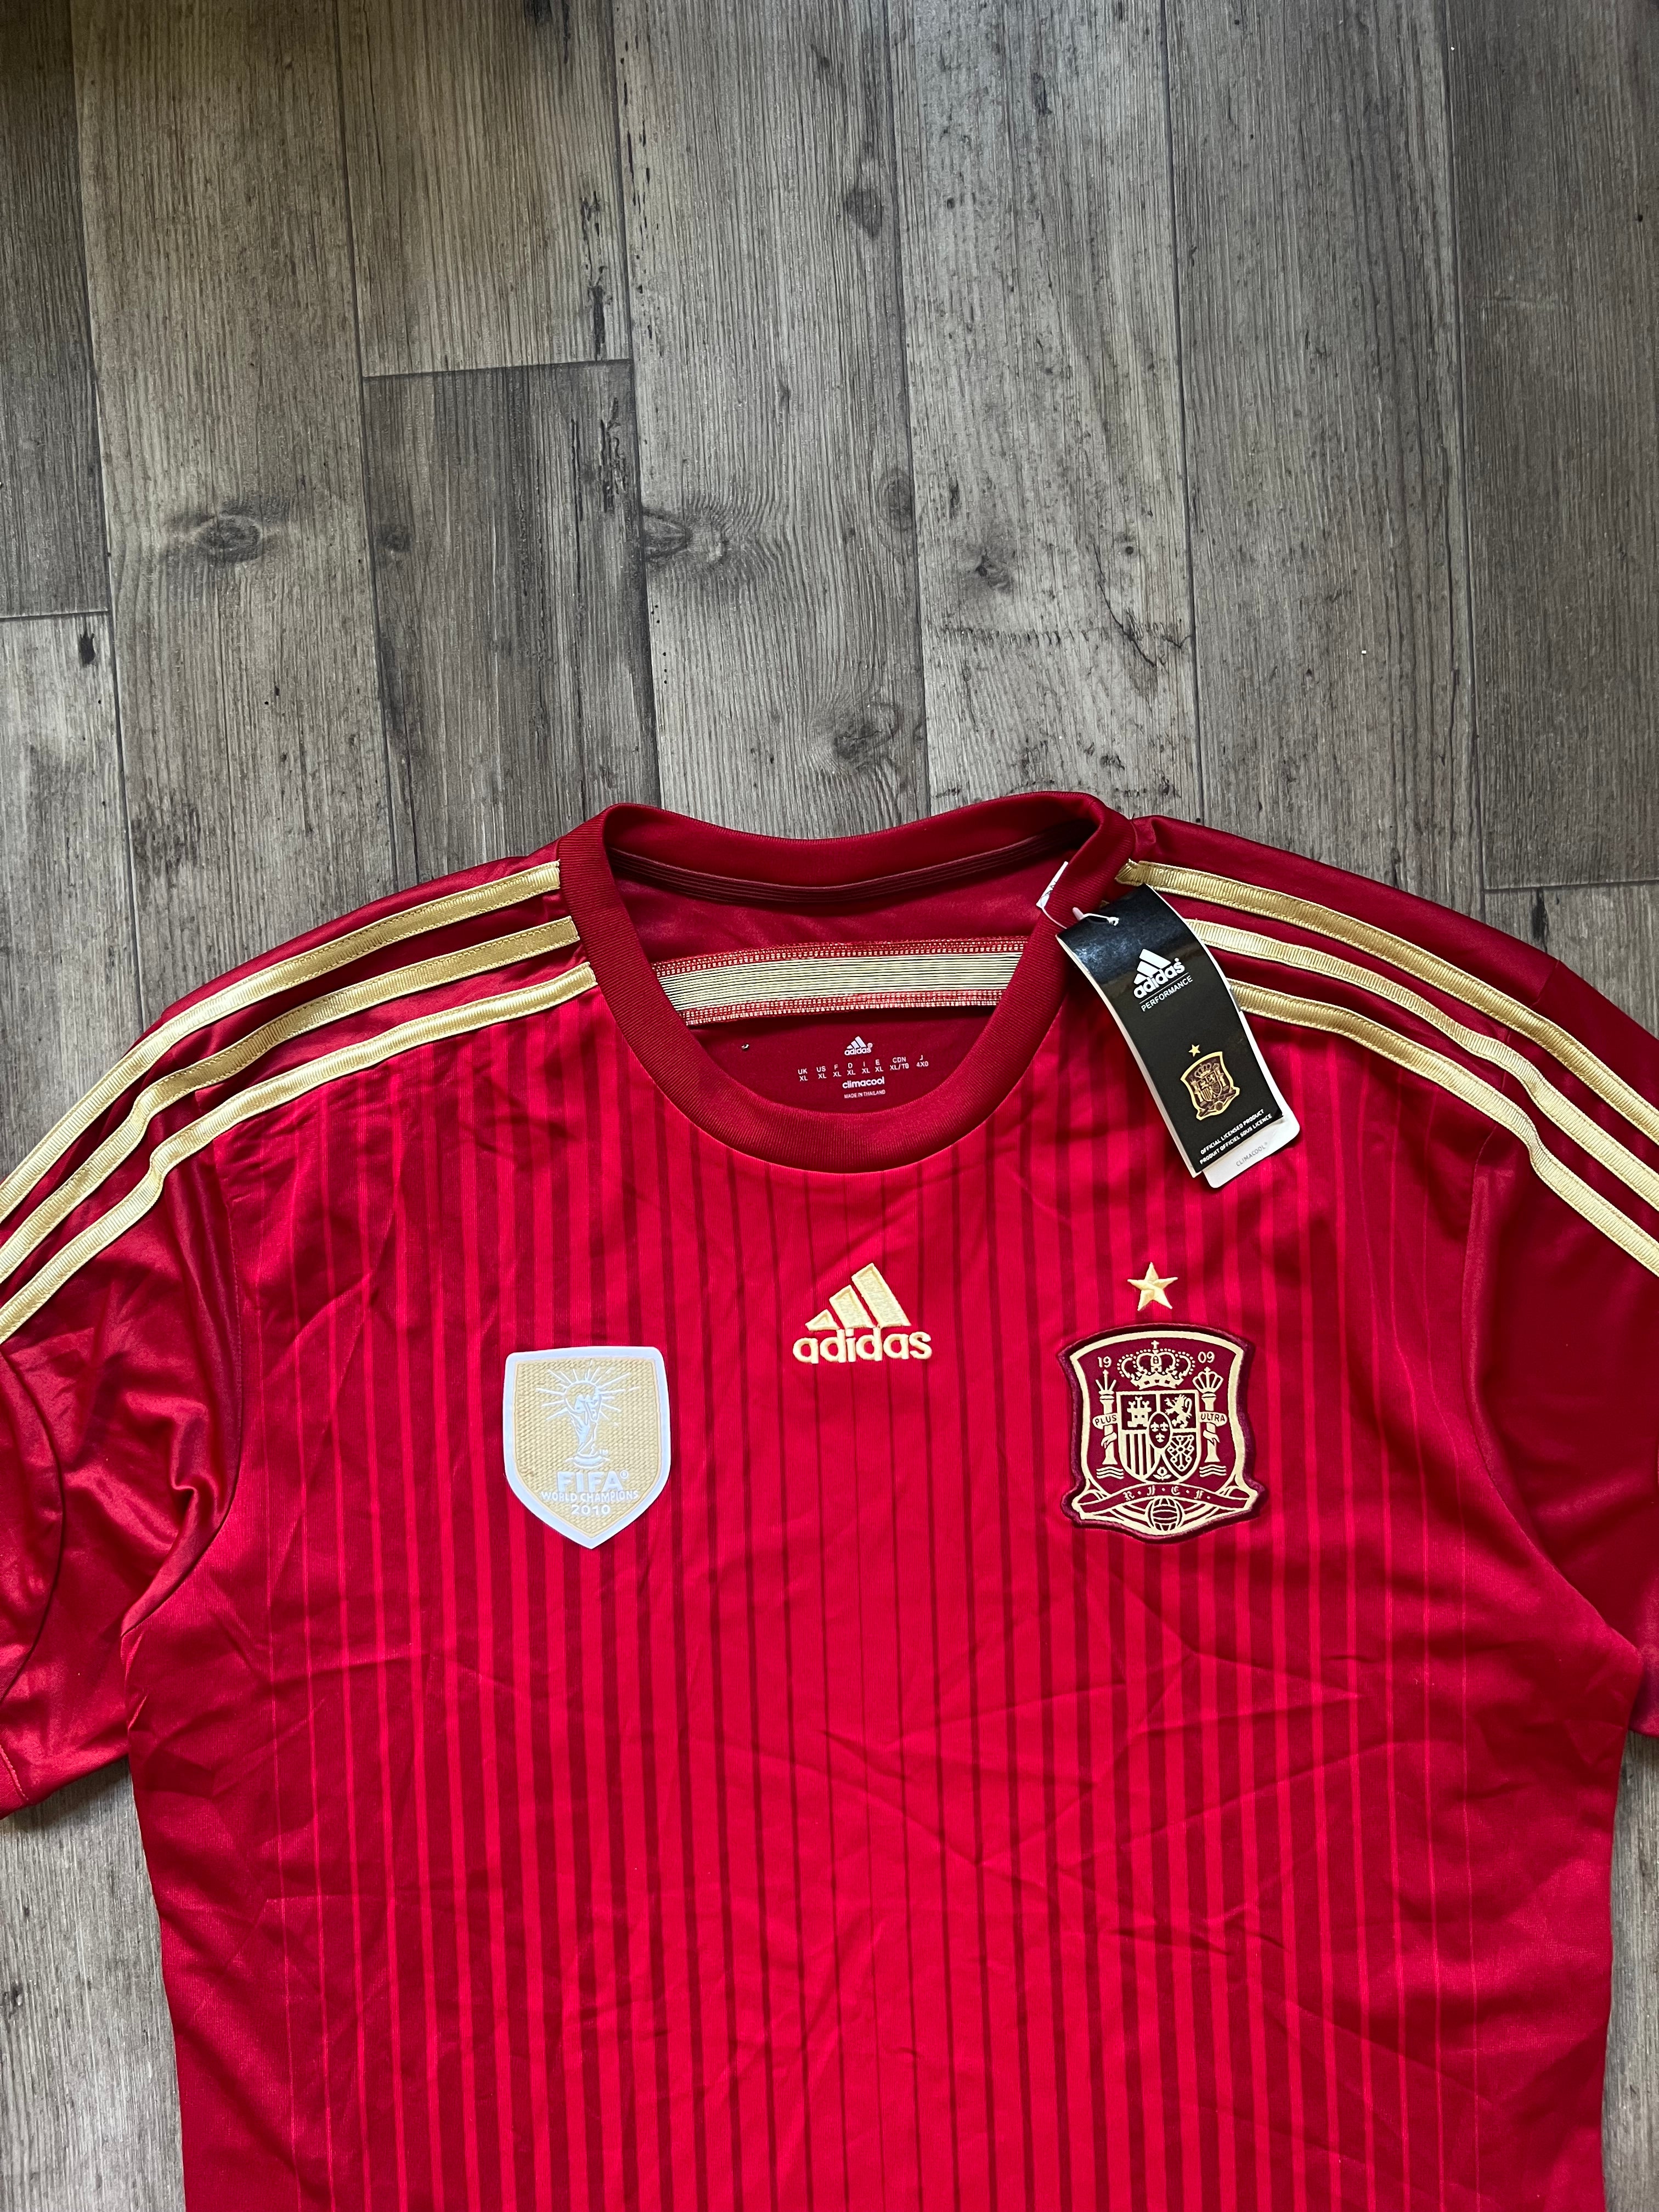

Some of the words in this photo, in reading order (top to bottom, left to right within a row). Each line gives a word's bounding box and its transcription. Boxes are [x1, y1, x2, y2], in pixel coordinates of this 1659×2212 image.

[1133, 962, 1185, 998] adidas
[1141, 975, 1193, 1012] PERFORMANCE
[844, 1047, 872, 1056] adidas
[842, 1076, 885, 1088] climacool
[1200, 1139, 1221, 1155] OFFICIAL
[1220, 1123, 1243, 1141] LICENSED
[1243, 1109, 1264, 1126] PRODUCT
[1199, 1148, 1220, 1165] PRODUIT
[1220, 1135, 1240, 1151] OFFICIEL
[1240, 1126, 1253, 1137] SOUS
[1252, 1113, 1272, 1129] LICENCE
[793, 1328, 933, 1364] adidas
[1095, 1414, 1117, 1425] PLUS
[1200, 1413, 1226, 1423] ULTRA
[541, 1491, 577, 1502] WORLD
[580, 1490, 639, 1503] CHAMPIONS
[571, 1504, 611, 1515] 2010
